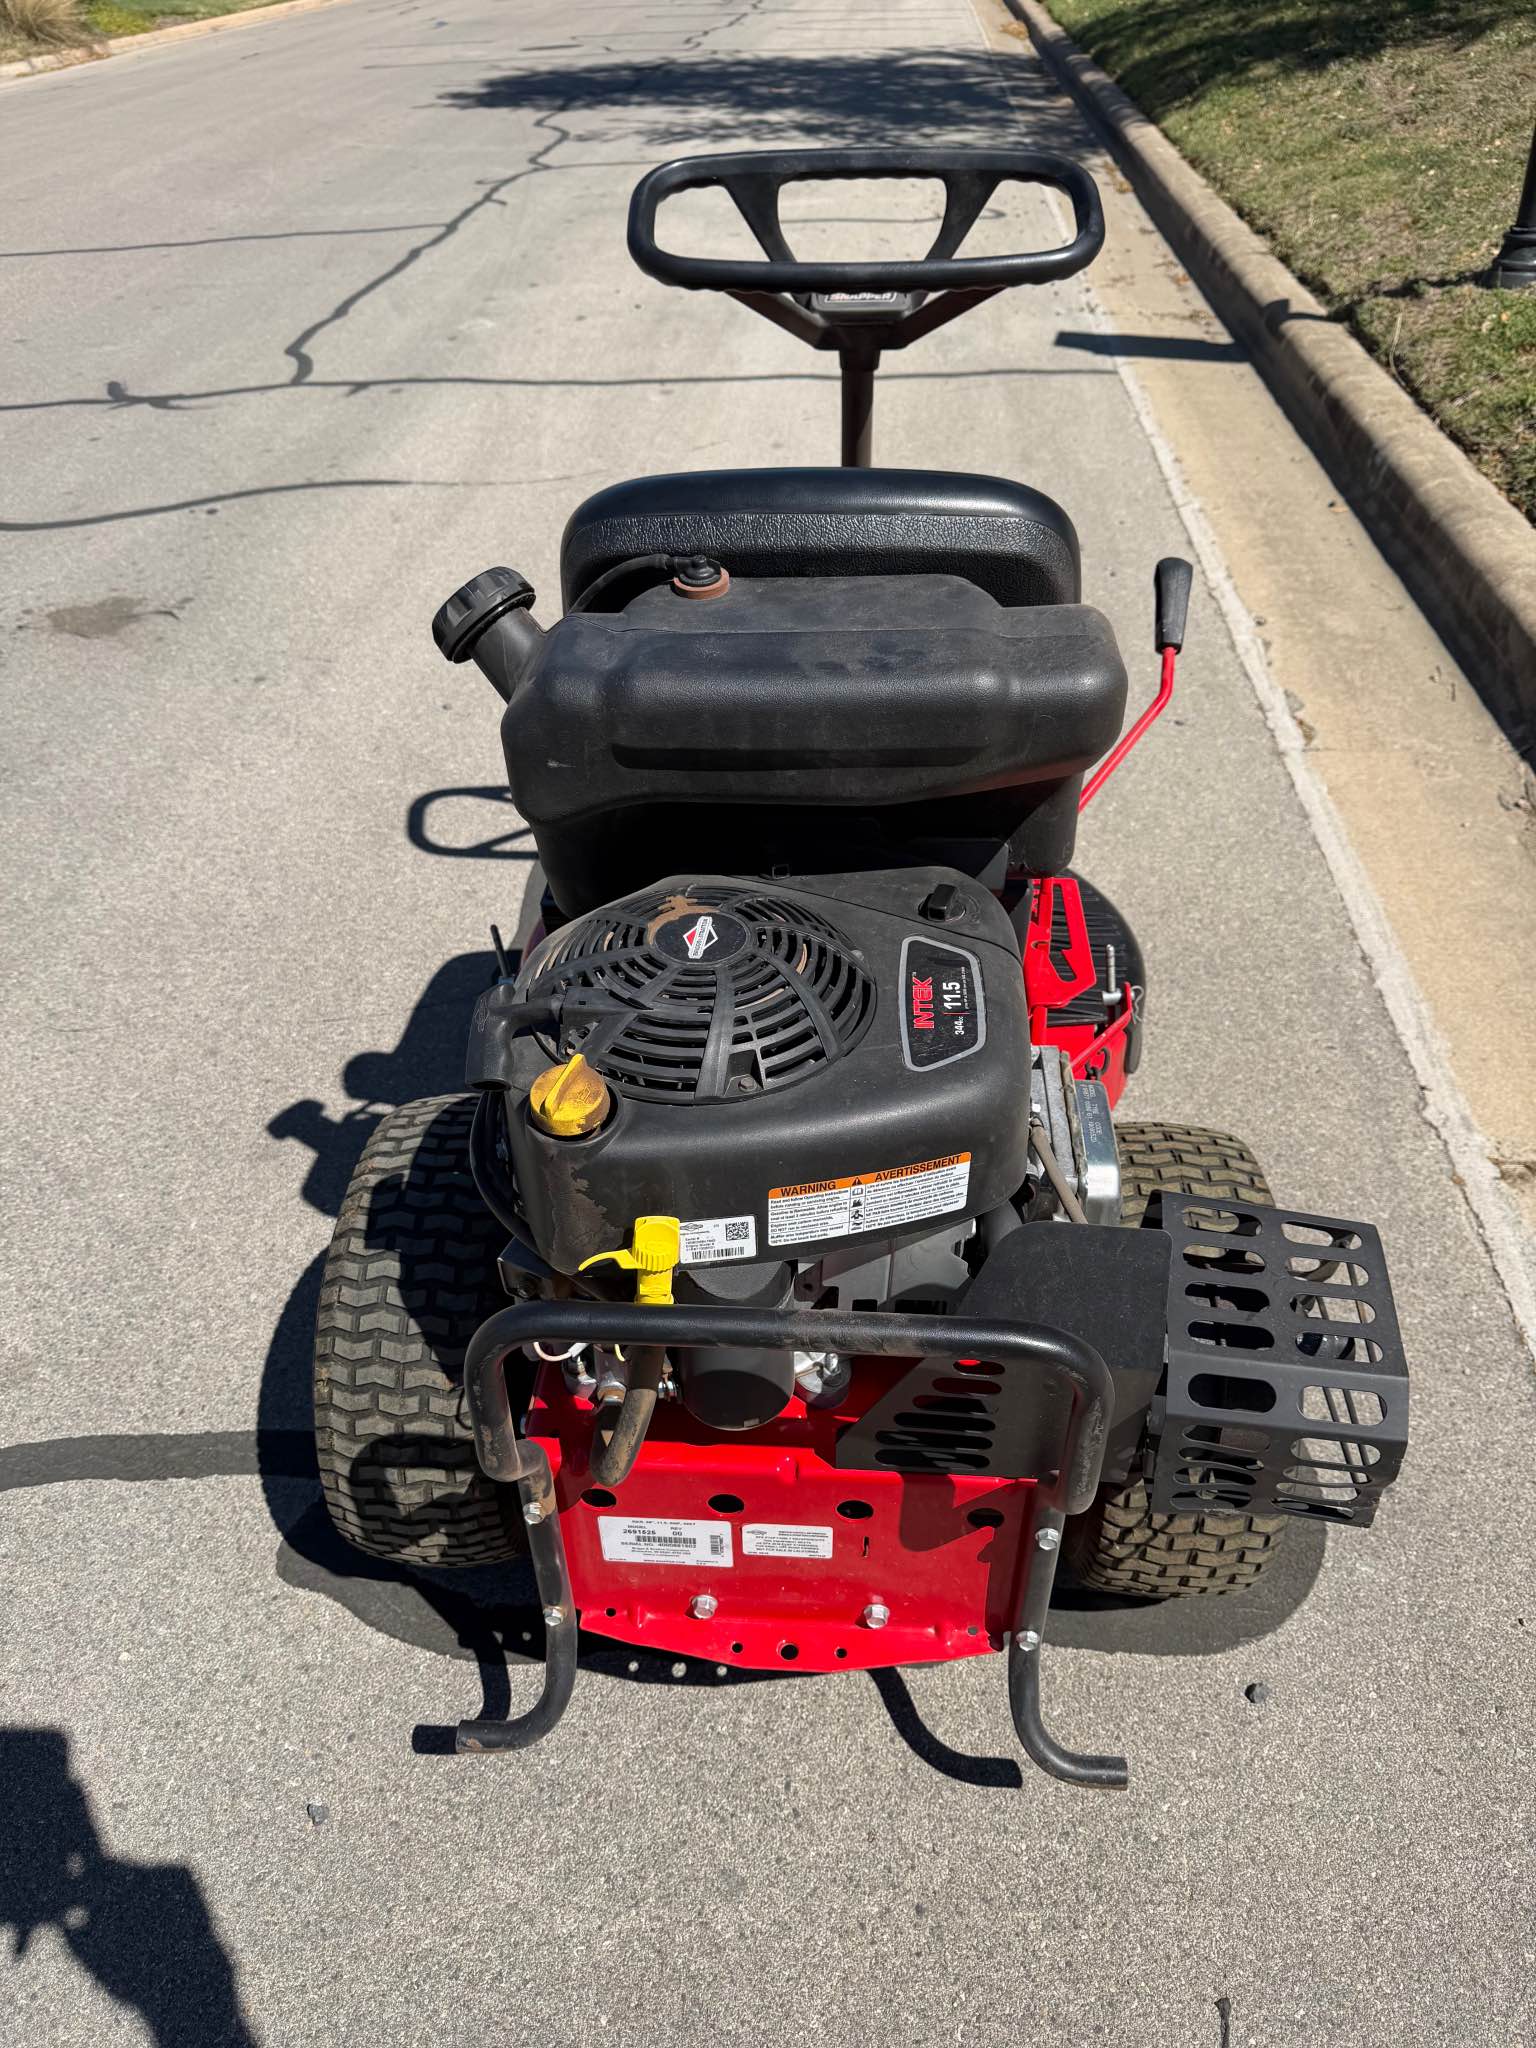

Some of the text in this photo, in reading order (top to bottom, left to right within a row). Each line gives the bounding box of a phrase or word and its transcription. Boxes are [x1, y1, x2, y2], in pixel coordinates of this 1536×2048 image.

[912, 977, 934, 1029] INTEK
[942, 982, 961, 1009] 11.5
[875, 1155, 961, 1182] AVERTISSEMENT
[780, 1181, 836, 1197] WARNING
